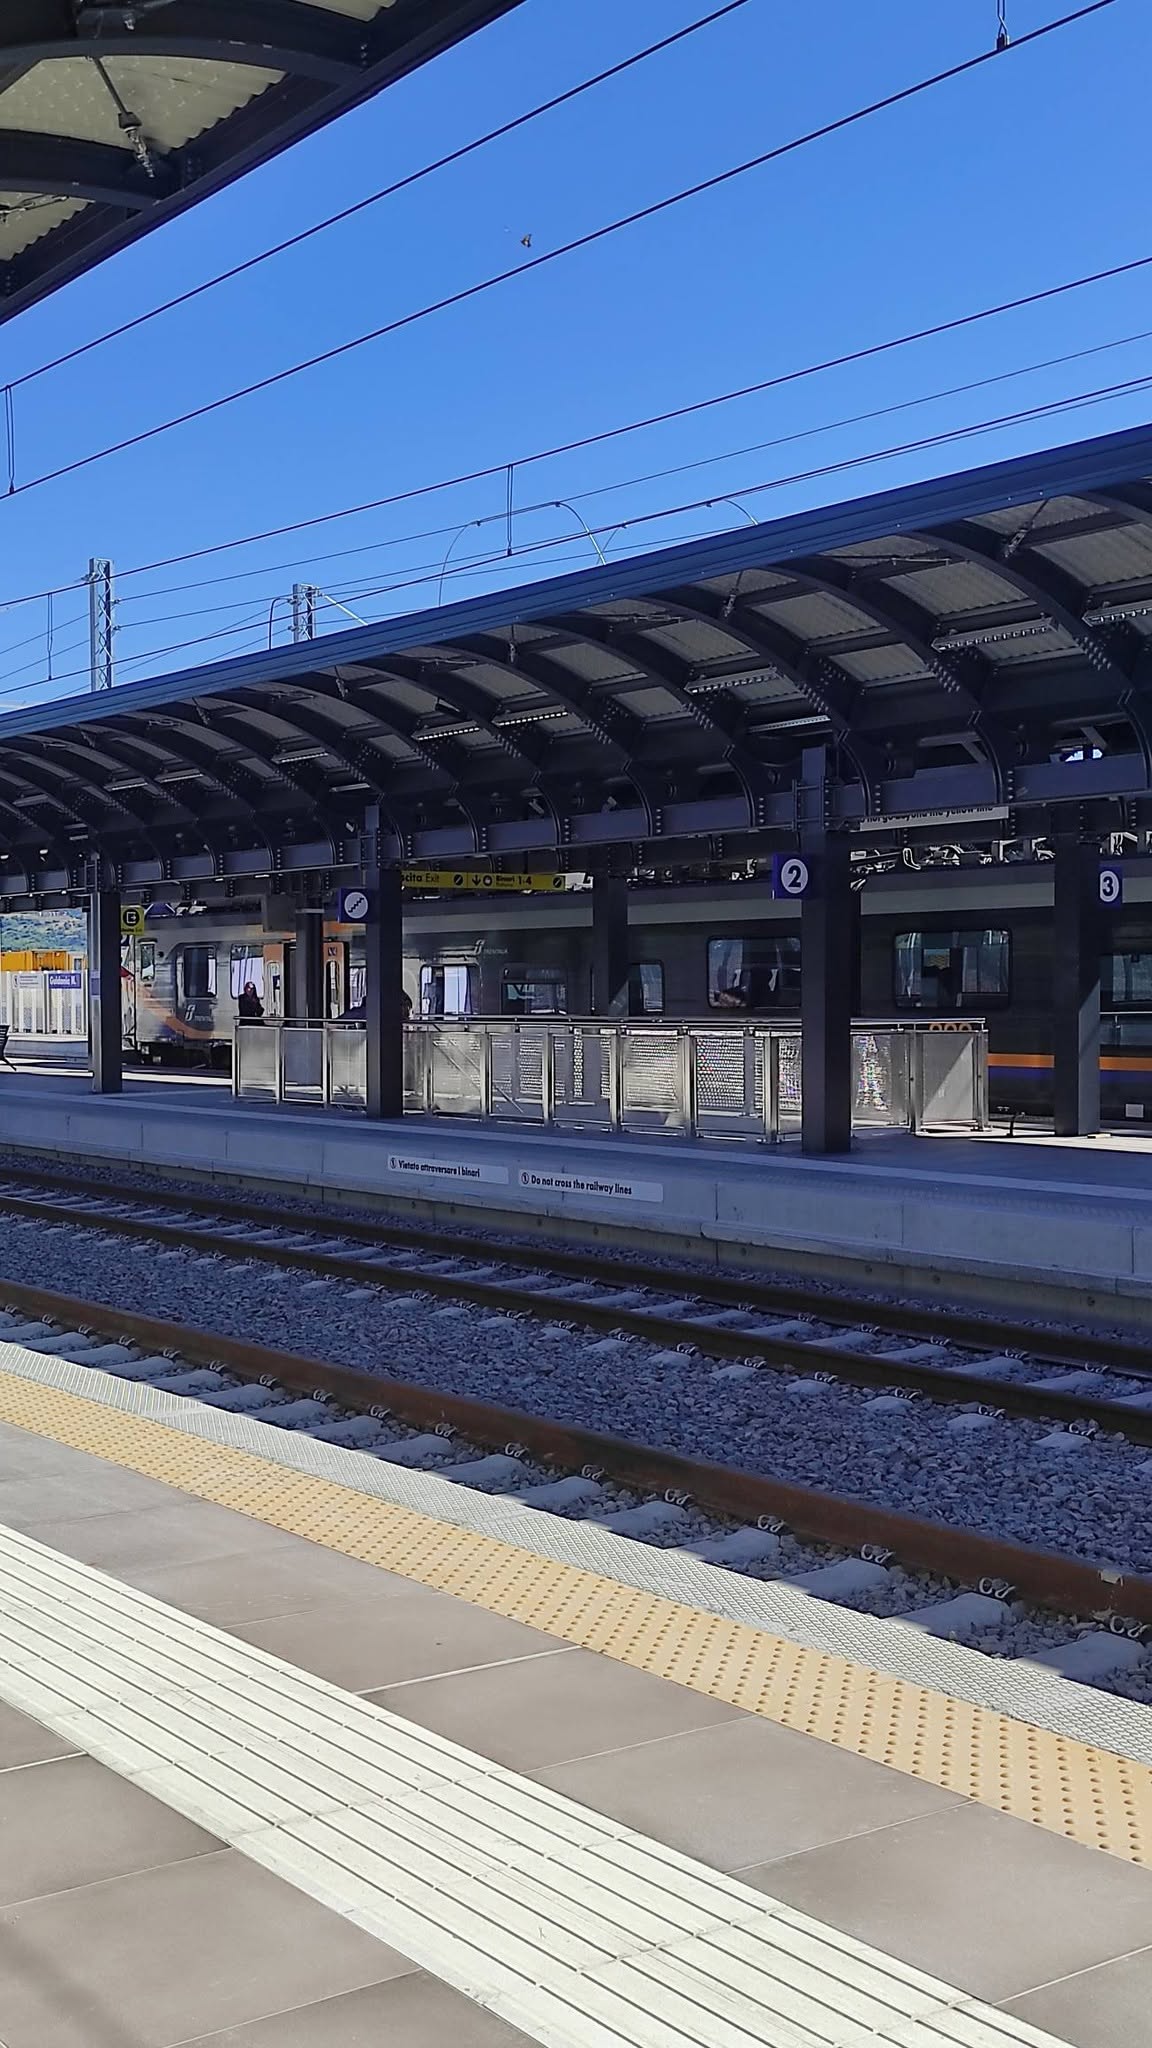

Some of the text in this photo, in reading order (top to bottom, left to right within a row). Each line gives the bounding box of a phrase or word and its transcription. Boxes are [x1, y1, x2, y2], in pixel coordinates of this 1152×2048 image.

[425, 872, 440, 883] Exit
[788, 865, 802, 887] 2
[1102, 876, 1114, 896] 3
[398, 1159, 420, 1171] Vietato
[420, 1164, 457, 1176] attraversare
[461, 1165, 480, 1178] binari
[531, 1174, 632, 1195] Do not cross the railway lines
